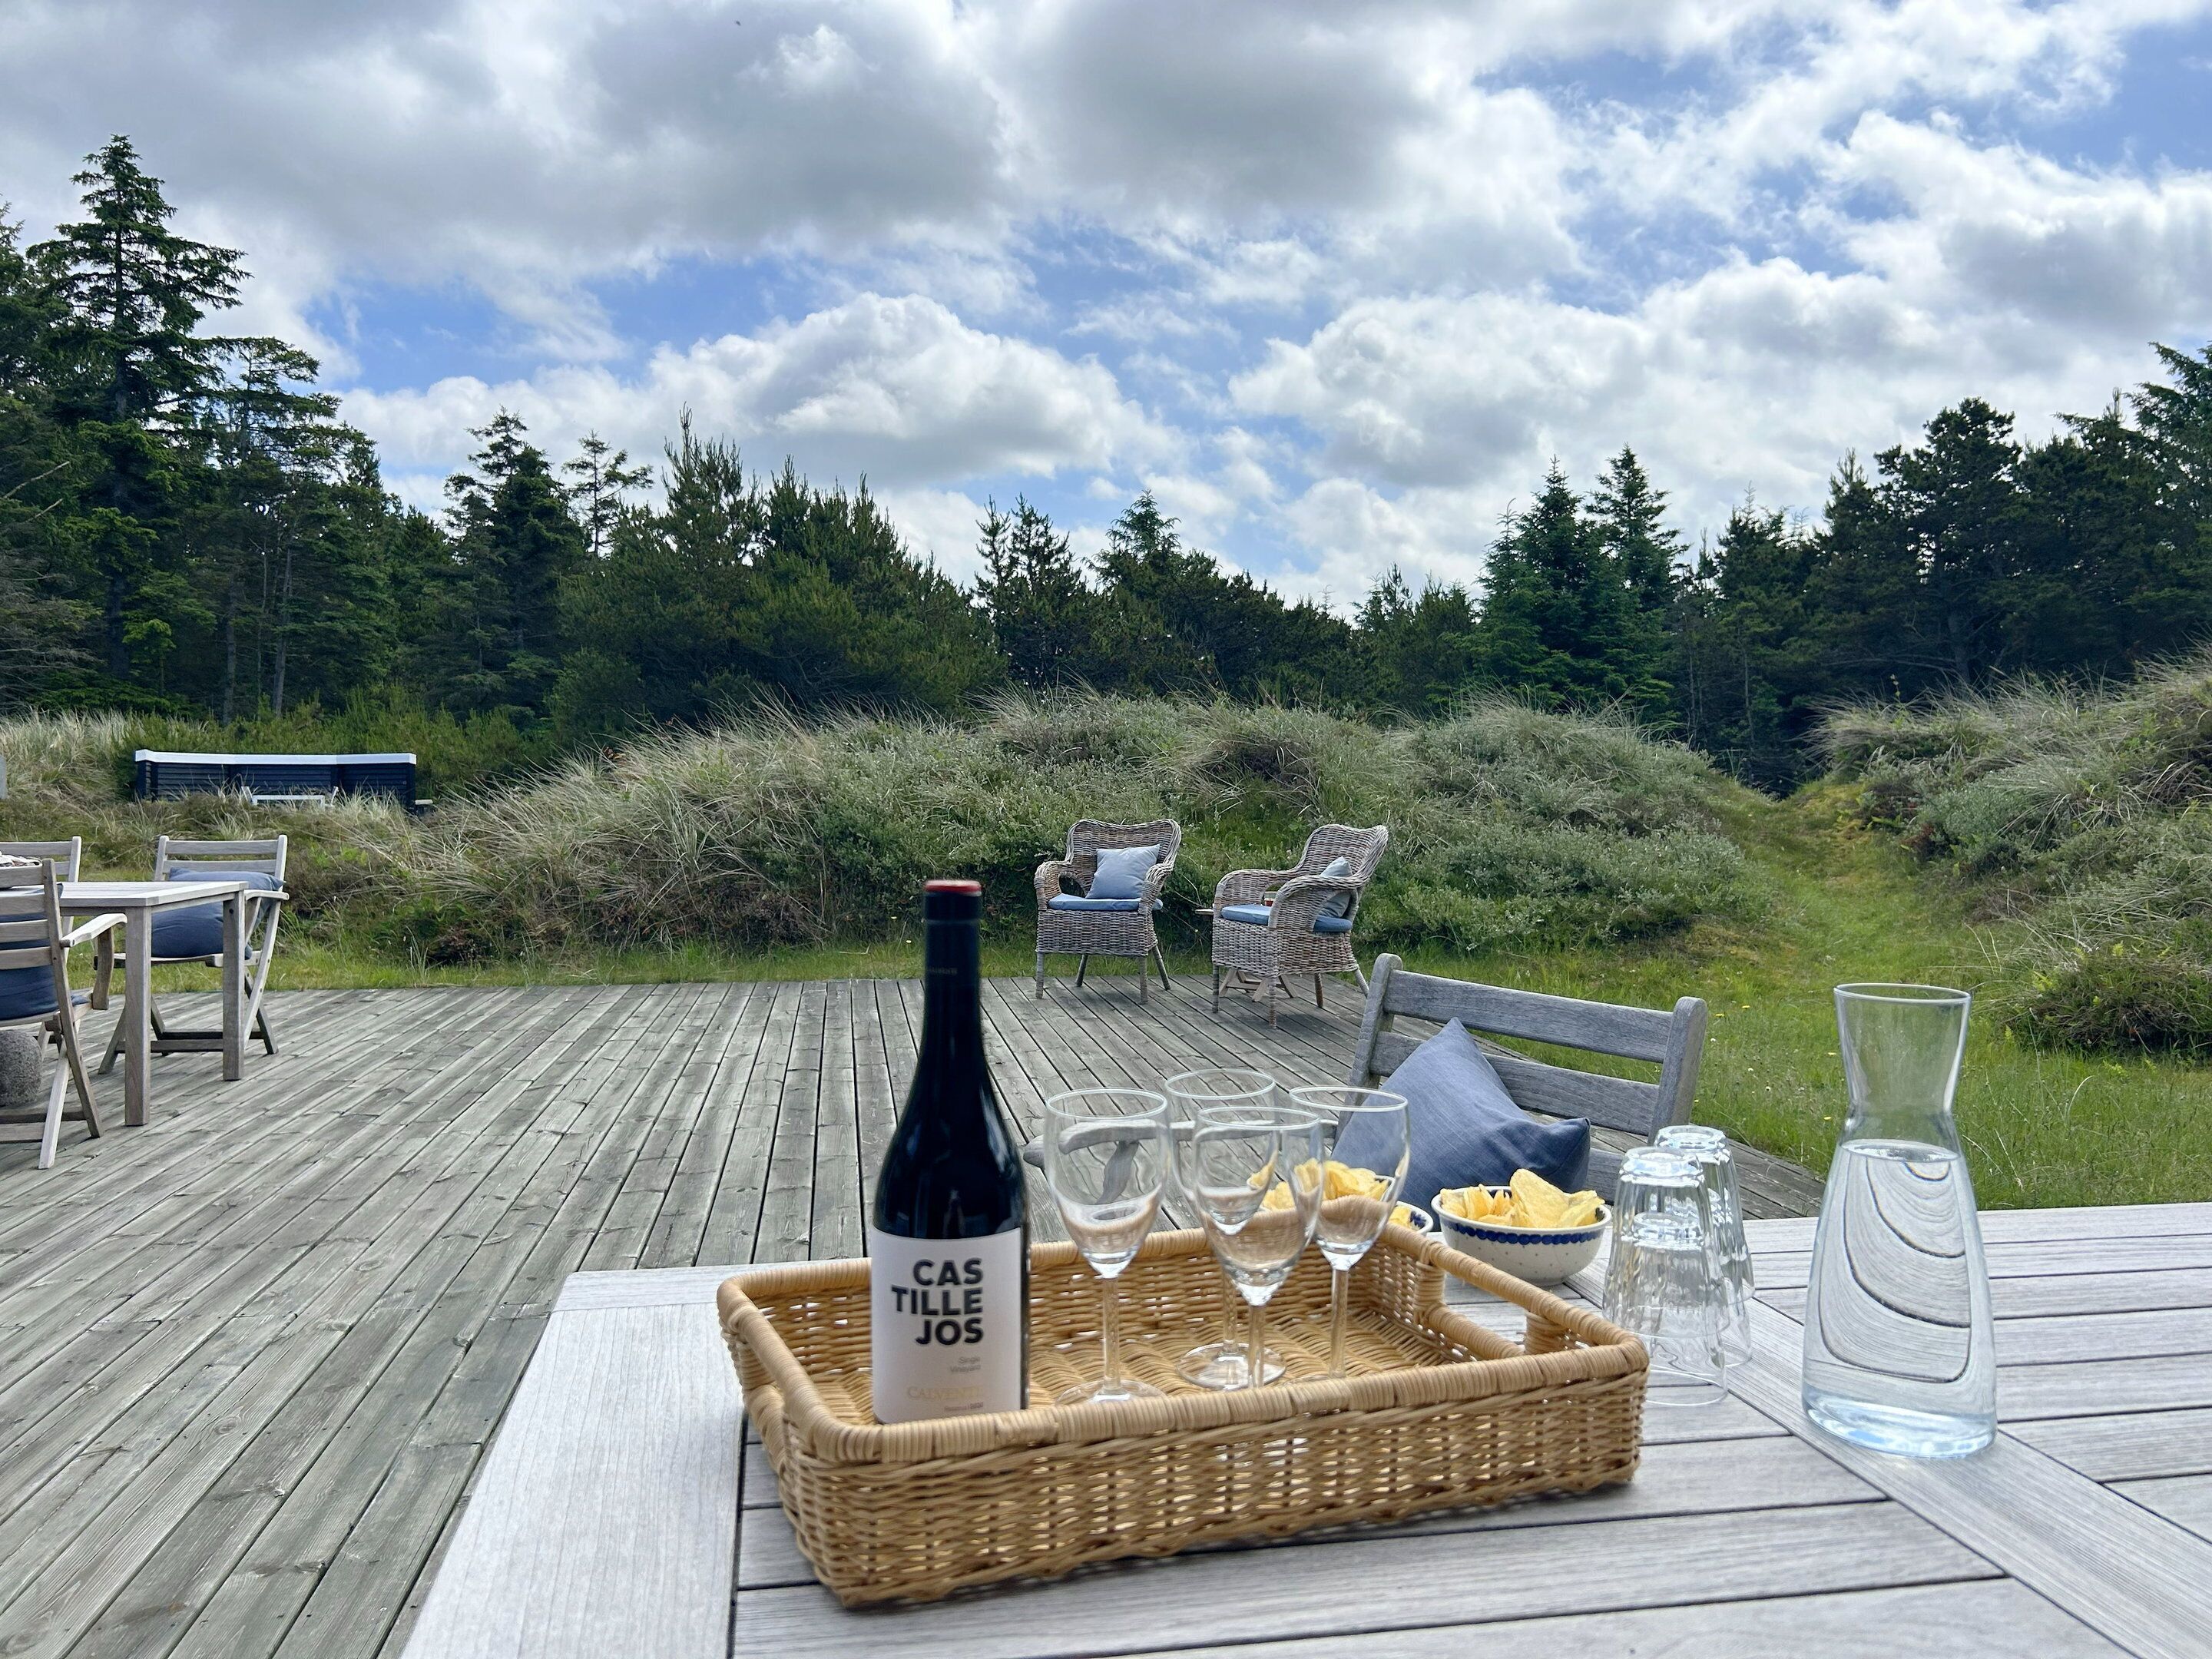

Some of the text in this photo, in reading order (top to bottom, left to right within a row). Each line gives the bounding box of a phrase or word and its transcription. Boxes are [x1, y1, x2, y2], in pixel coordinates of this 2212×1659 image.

[913, 1258, 984, 1286] CAS
[891, 1285, 983, 1316] TILLE
[915, 1317, 984, 1346] JOS
